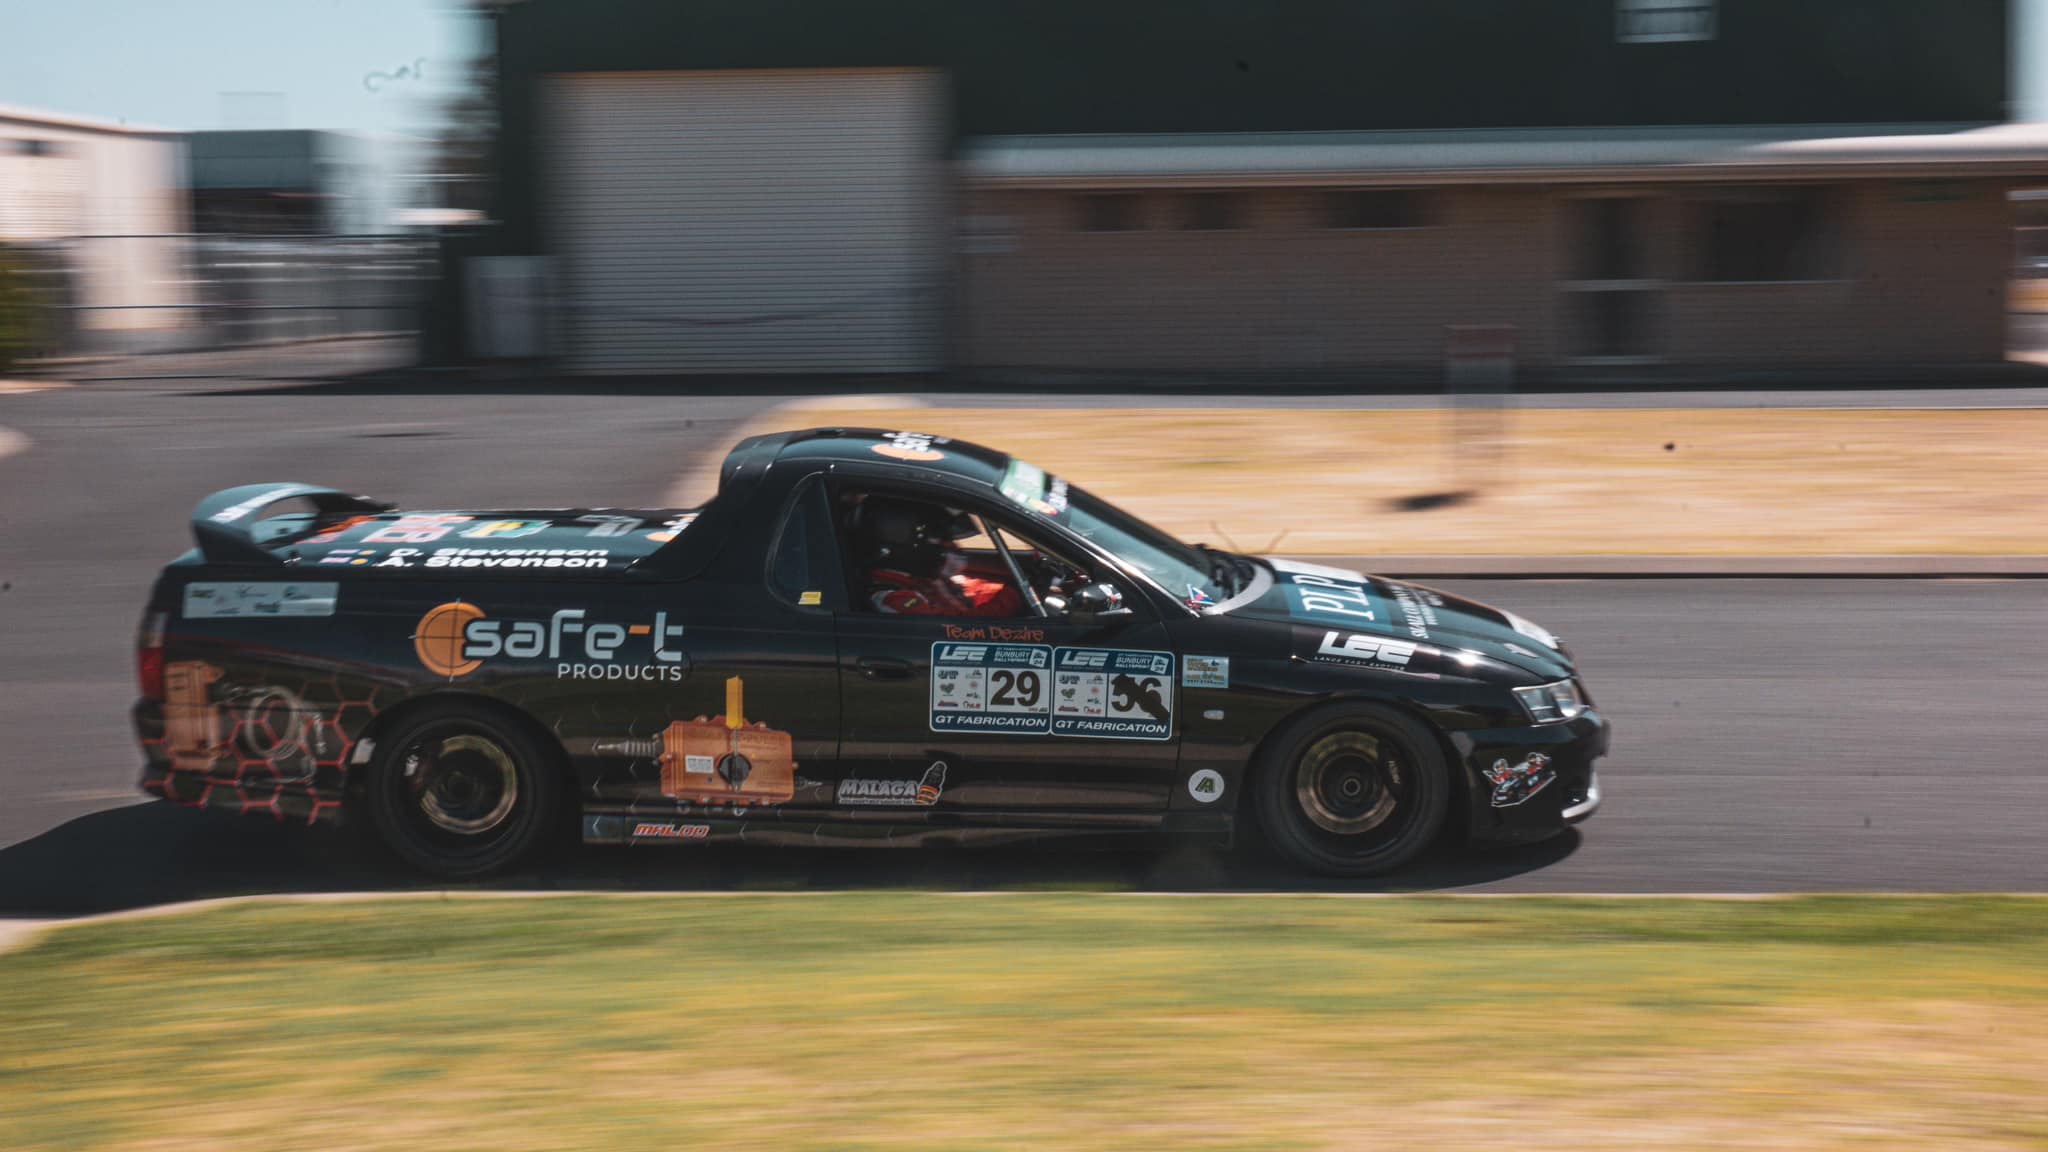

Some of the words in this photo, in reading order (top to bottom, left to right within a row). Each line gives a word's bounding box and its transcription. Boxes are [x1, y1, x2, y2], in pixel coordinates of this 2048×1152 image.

[433, 548, 609, 556] Stevenson
[424, 556, 608, 568] Stevenson
[943, 623, 986, 640] Team
[940, 645, 988, 661] LEE
[1317, 631, 1418, 665] LEE
[1061, 651, 1109, 667] LEE
[557, 663, 682, 682] PRODUCTS
[990, 670, 1041, 707] 29
[935, 714, 955, 724] GT
[957, 715, 1047, 727] FABRICATION
[1055, 719, 1075, 729] GT
[1077, 721, 1167, 734] FABRICATION
[840, 779, 918, 796] MALAGA
